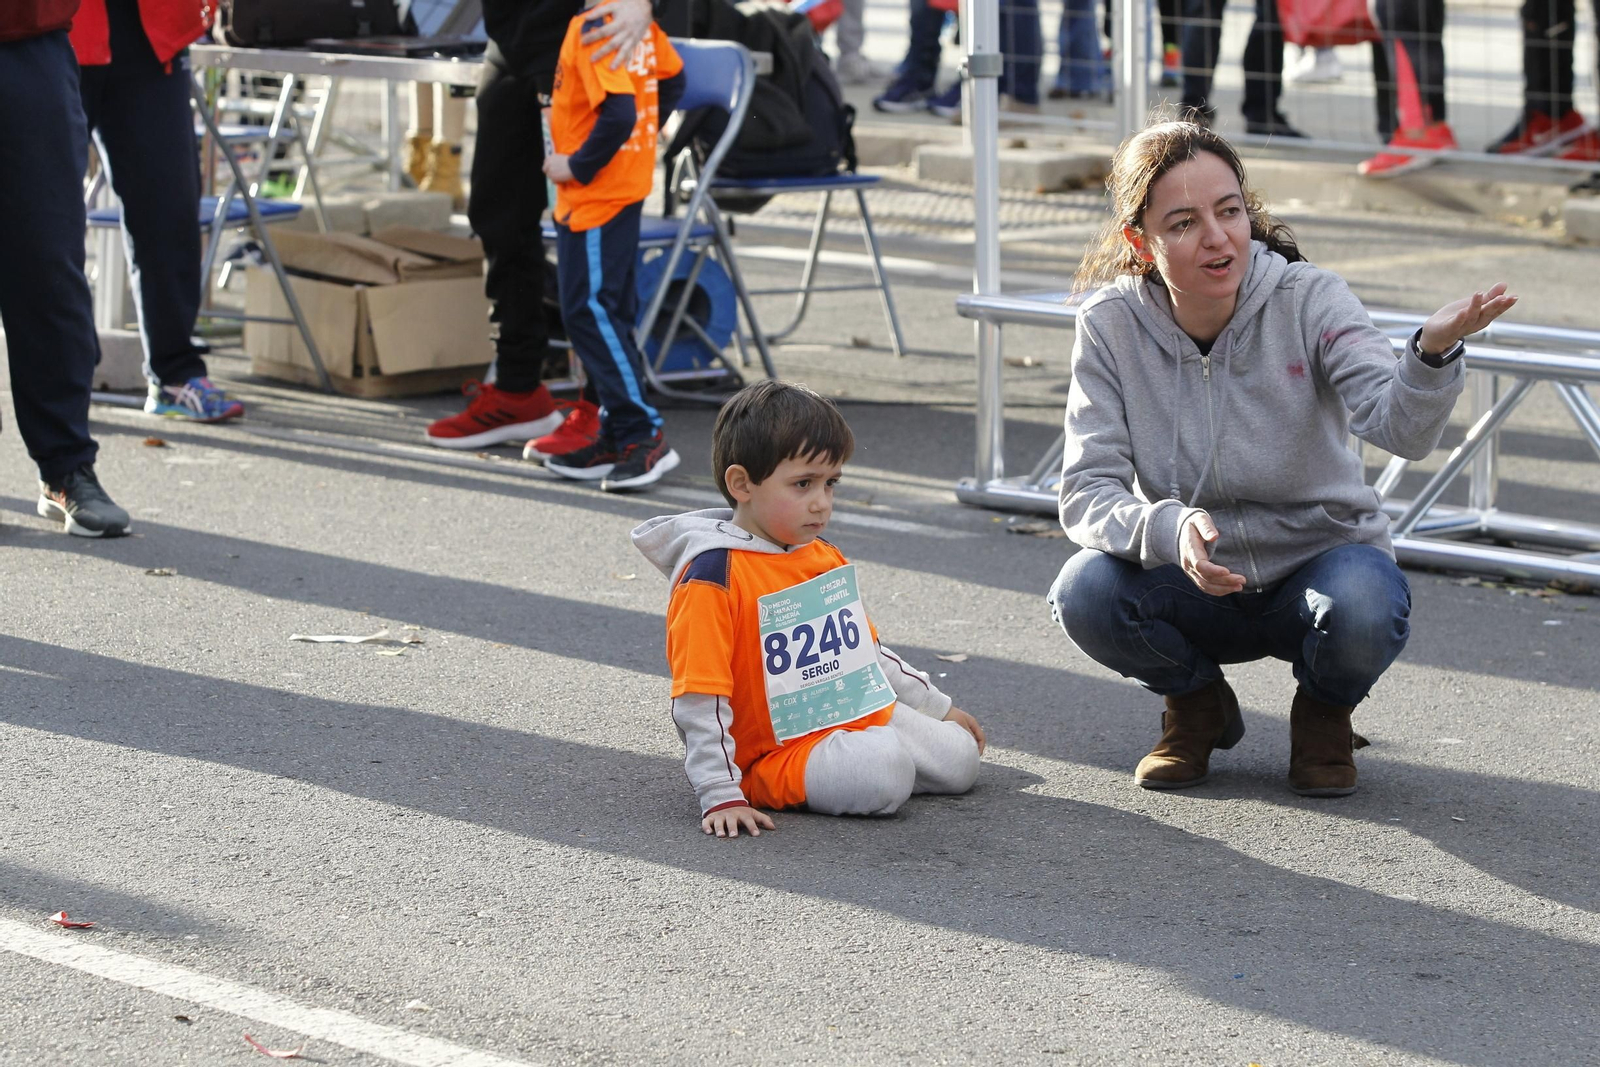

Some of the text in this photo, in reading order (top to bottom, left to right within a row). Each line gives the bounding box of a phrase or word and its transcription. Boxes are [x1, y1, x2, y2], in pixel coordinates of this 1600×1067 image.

[772, 598, 791, 609] MEDIO
[823, 588, 850, 606] INFANTIL
[775, 610, 800, 623] ALMERÍA
[764, 607, 860, 676] 8246
[802, 659, 840, 681] SERGIO
[800, 680, 815, 689] SERGIO
[815, 676, 830, 685] VARGAS
